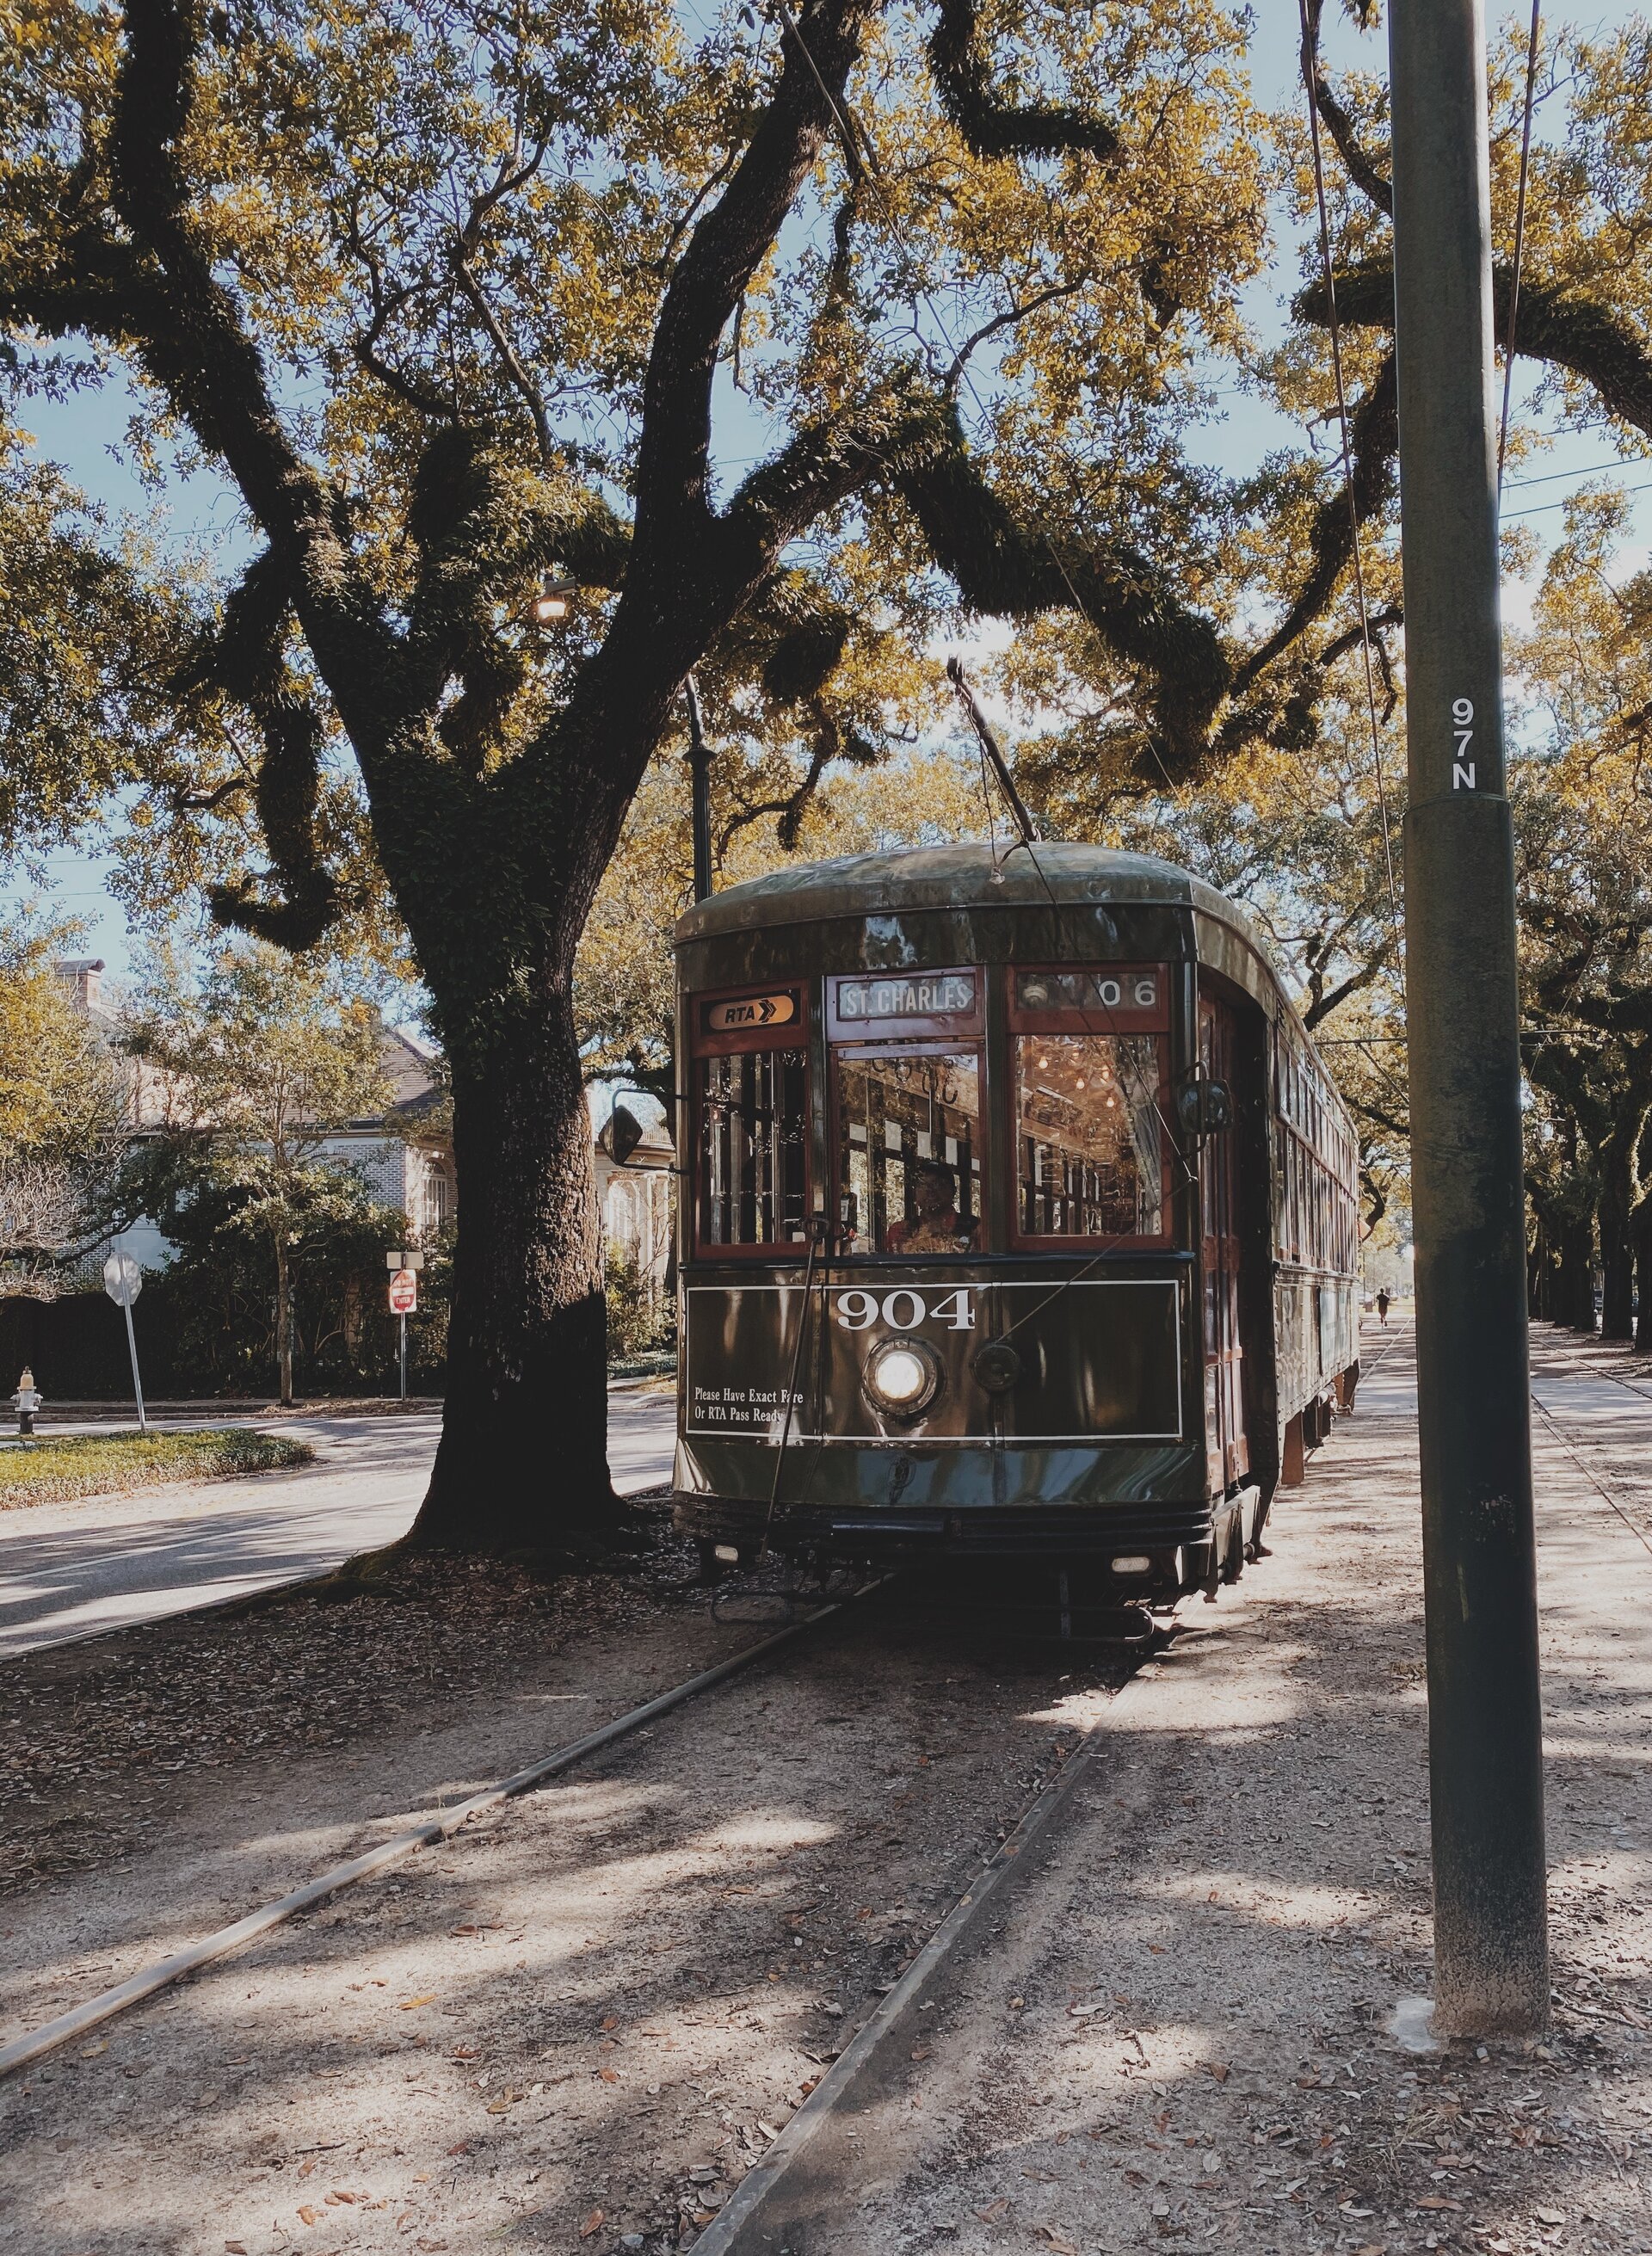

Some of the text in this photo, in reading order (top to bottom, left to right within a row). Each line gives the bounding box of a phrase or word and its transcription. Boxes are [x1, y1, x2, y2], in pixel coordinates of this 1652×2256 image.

[847, 983, 969, 1015] ST. CHARLES
[724, 1005, 755, 1023] RTA
[837, 1290, 976, 1330] 904
[694, 1386, 720, 1401] Please
[723, 1387, 745, 1402] Have
[749, 1388, 777, 1402] Exact
[694, 1405, 784, 1424] Or RTA Pass Ready
